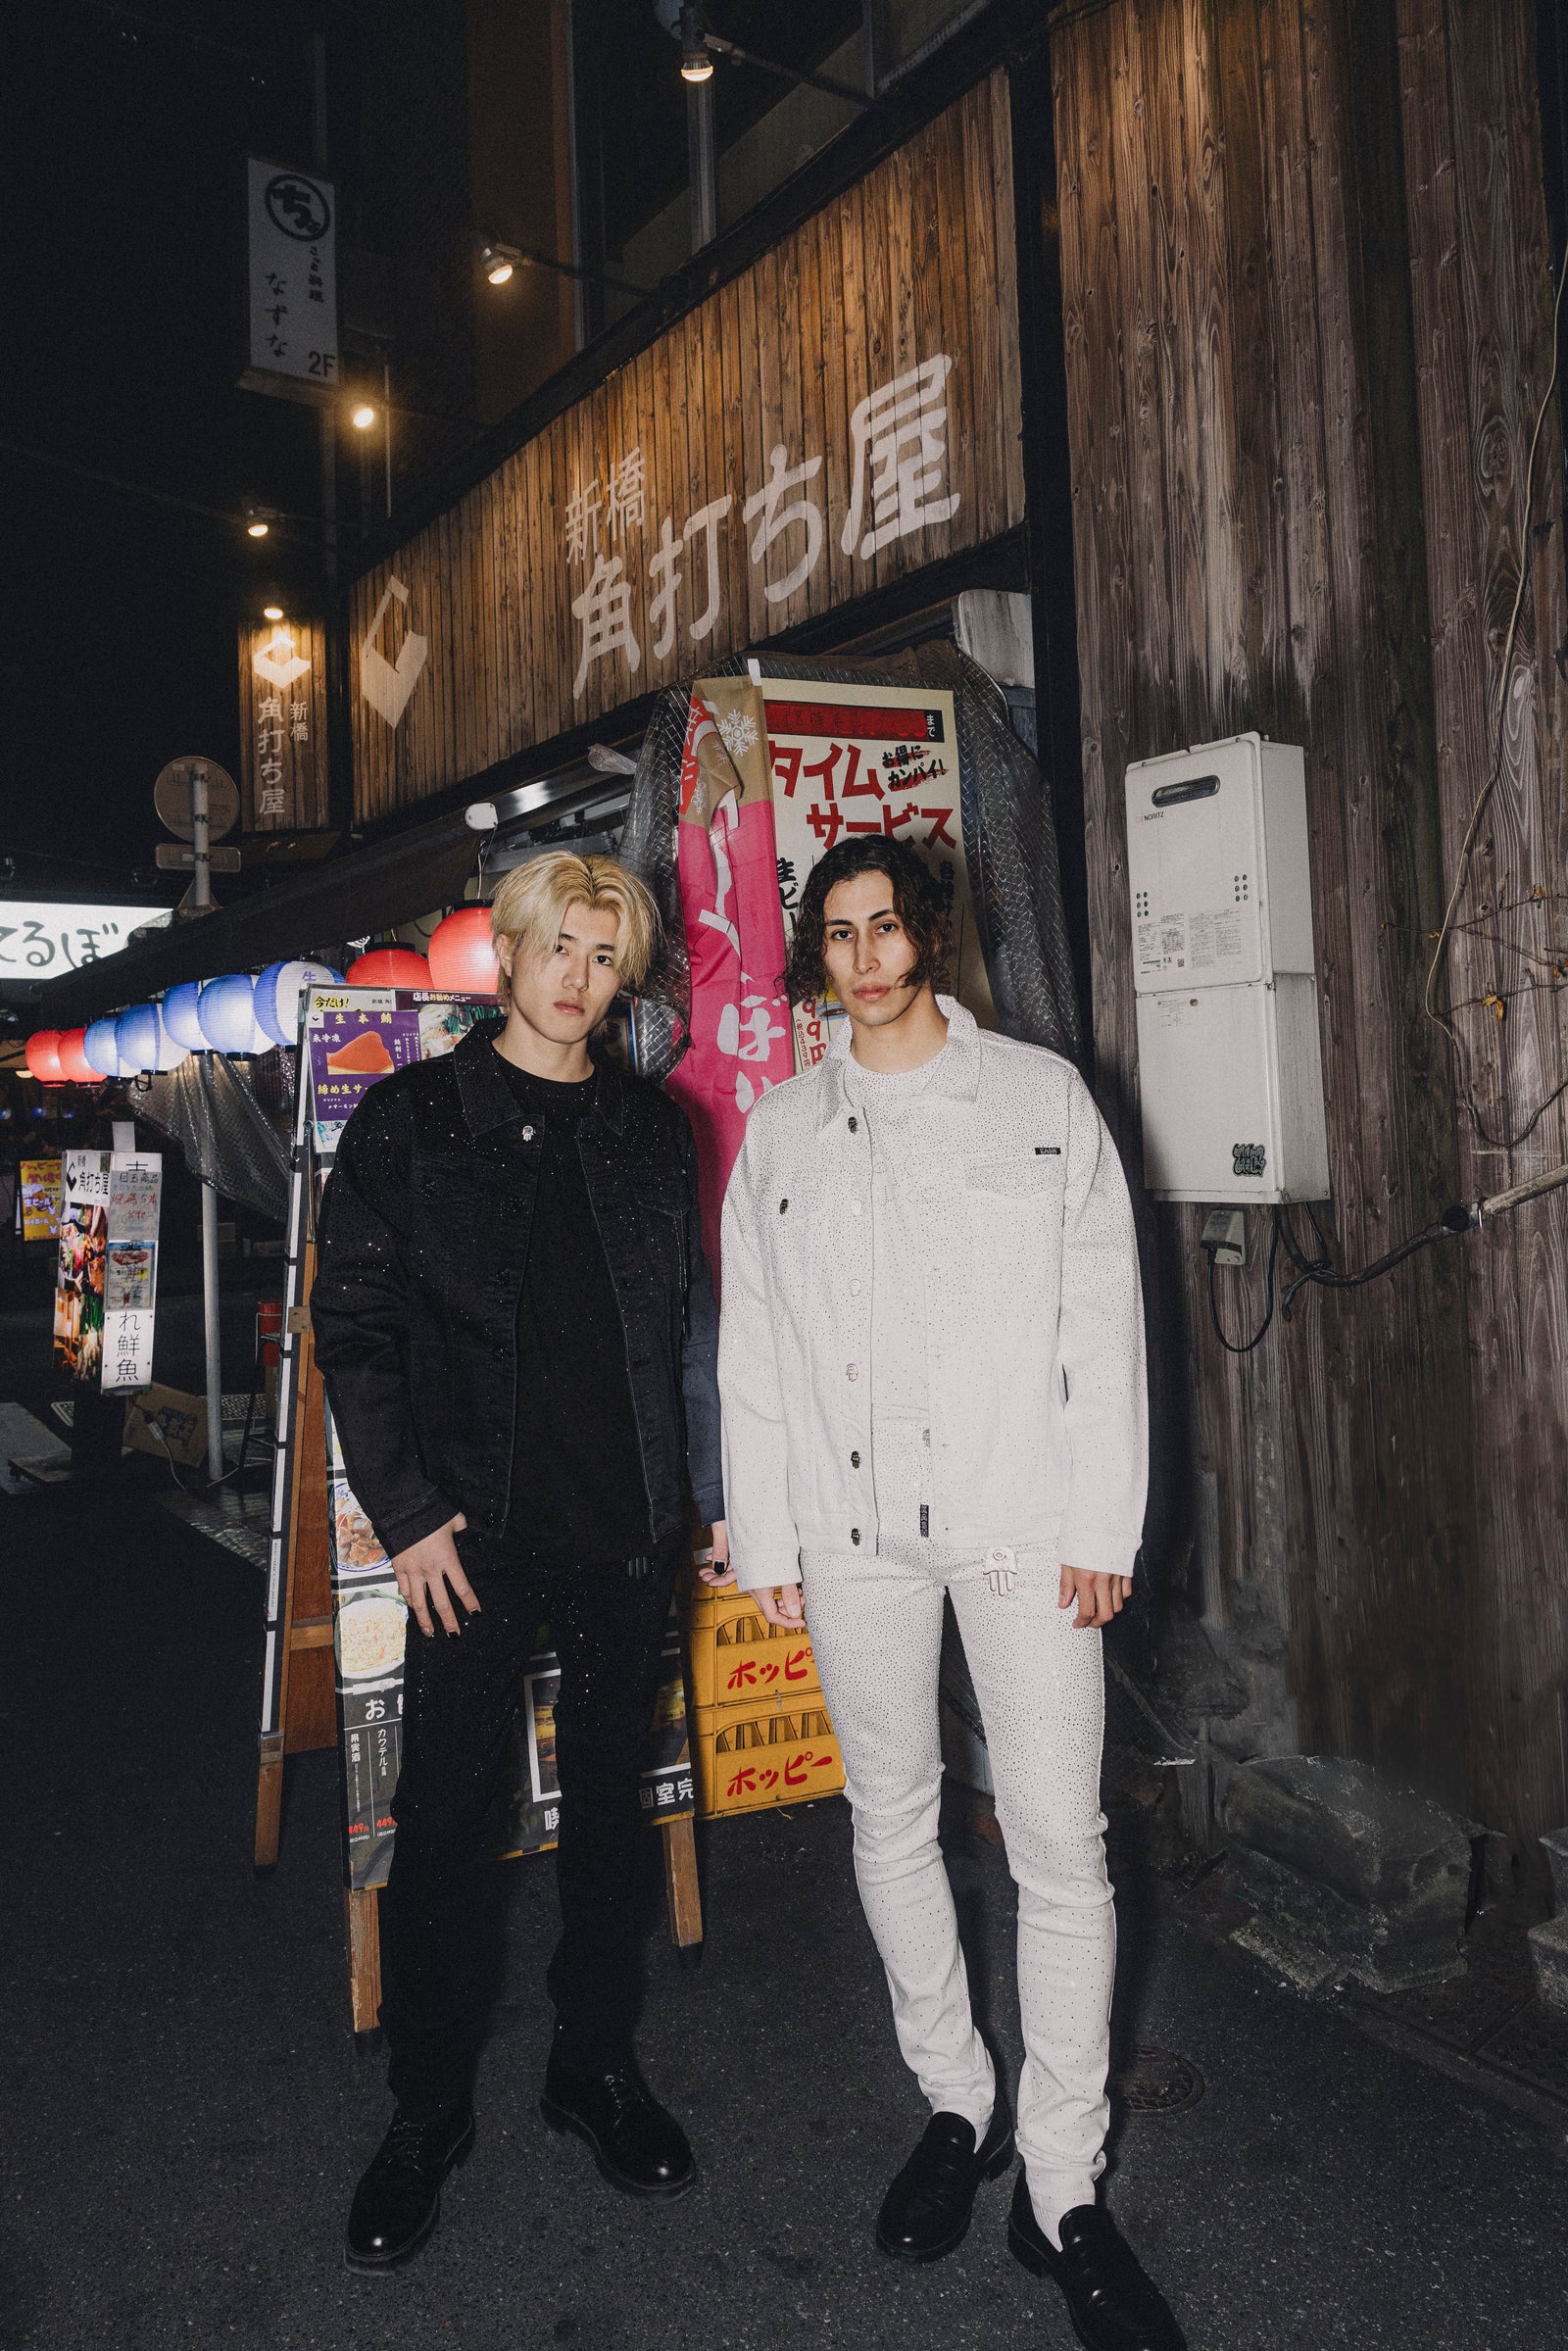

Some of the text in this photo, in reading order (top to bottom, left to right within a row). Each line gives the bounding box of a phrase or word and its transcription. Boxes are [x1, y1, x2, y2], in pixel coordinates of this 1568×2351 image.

[264, 271, 289, 359] なずな
[308, 350, 335, 378] 2F
[564, 446, 646, 566] 新橋
[570, 352, 961, 700] 角打ち屋
[290, 701, 309, 742] 新橋
[926, 713, 936, 739] まで
[257, 697, 286, 815] 角打ち屋
[769, 739, 884, 802] タイム
[882, 745, 923, 770] お得に
[807, 802, 957, 851] サービス
[1144, 810, 1165, 822] NORITZ
[314, 996, 349, 1009] 今だけ!
[377, 1728, 389, 1767] カクテル
[726, 1751, 833, 1796] ホッピー
